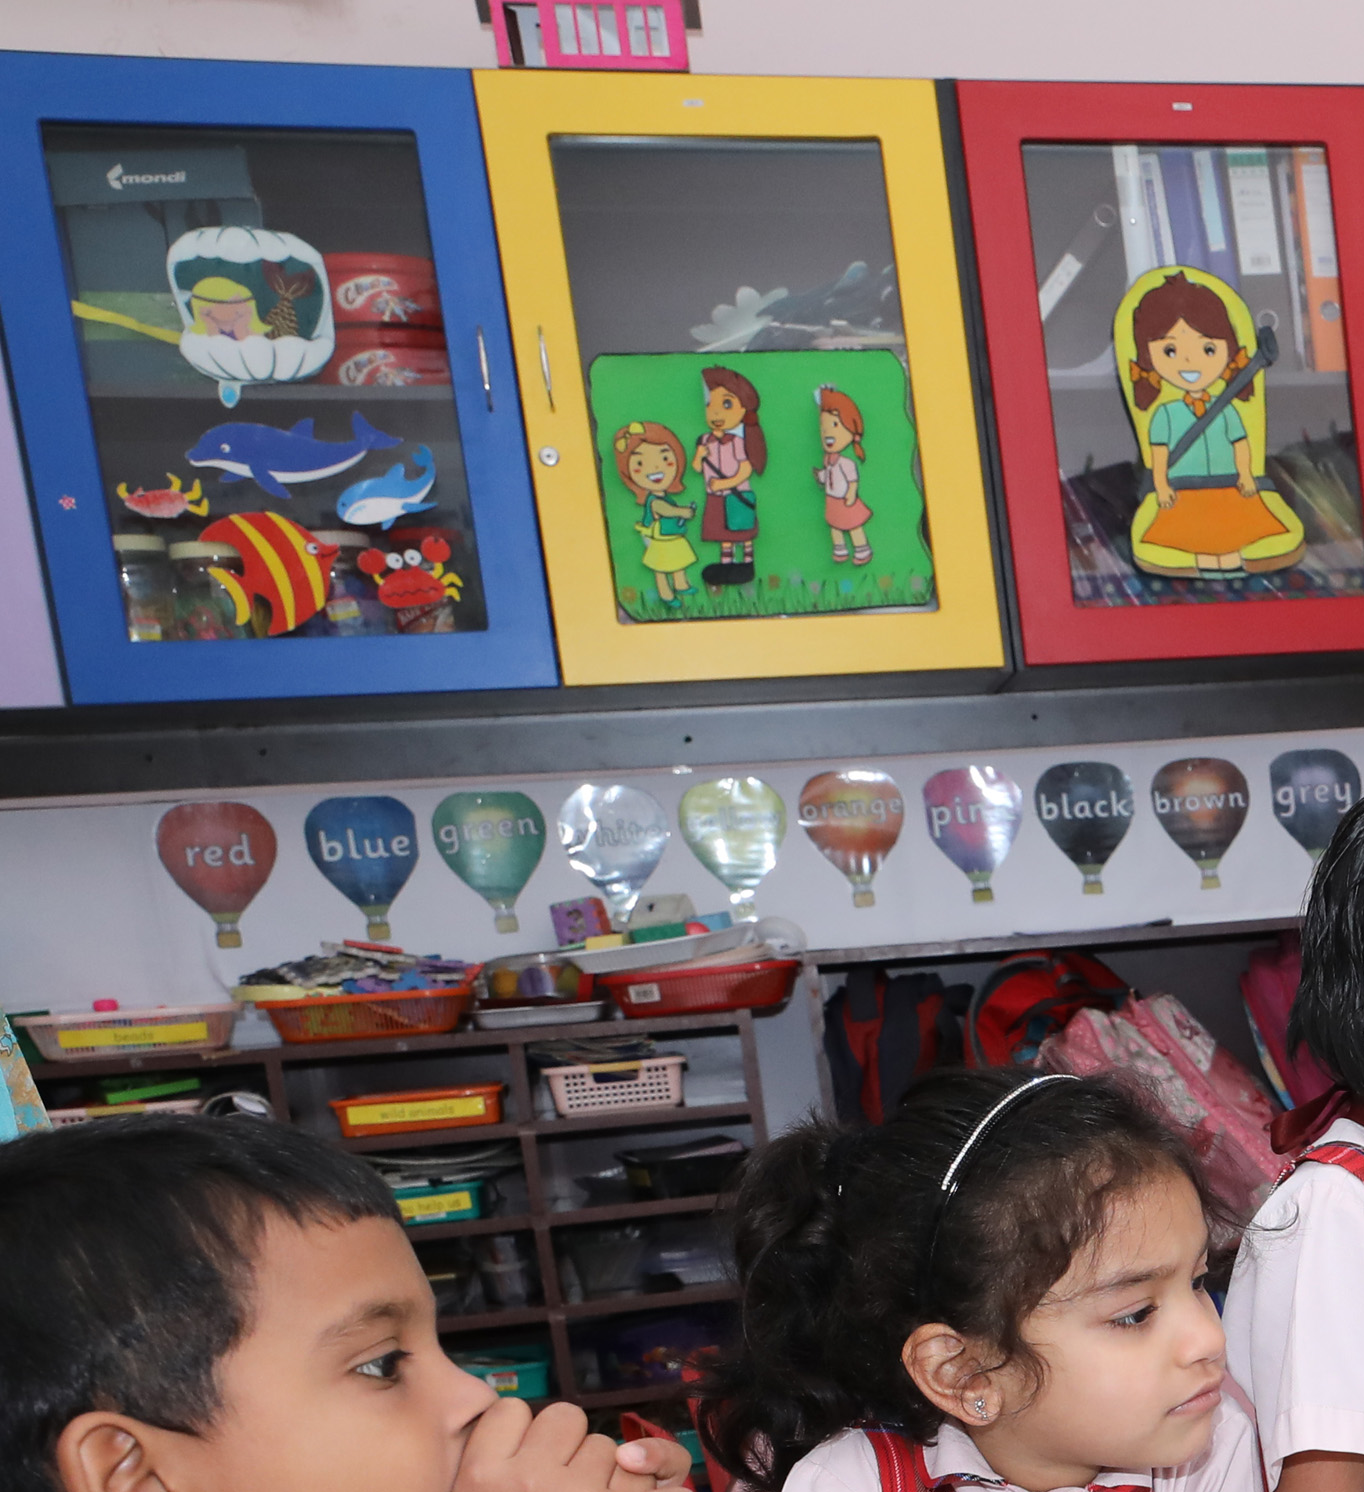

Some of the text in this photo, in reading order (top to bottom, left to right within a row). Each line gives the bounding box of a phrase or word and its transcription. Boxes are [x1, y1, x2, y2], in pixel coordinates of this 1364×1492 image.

[122, 170, 187, 184] mondi
[802, 796, 903, 826] orange
[1040, 792, 1132, 822] black
[1153, 788, 1248, 815] brown
[1276, 779, 1354, 819] grey
[438, 812, 541, 854] green
[929, 797, 1017, 838] pin
[185, 834, 256, 869] red
[317, 826, 413, 864] blue
